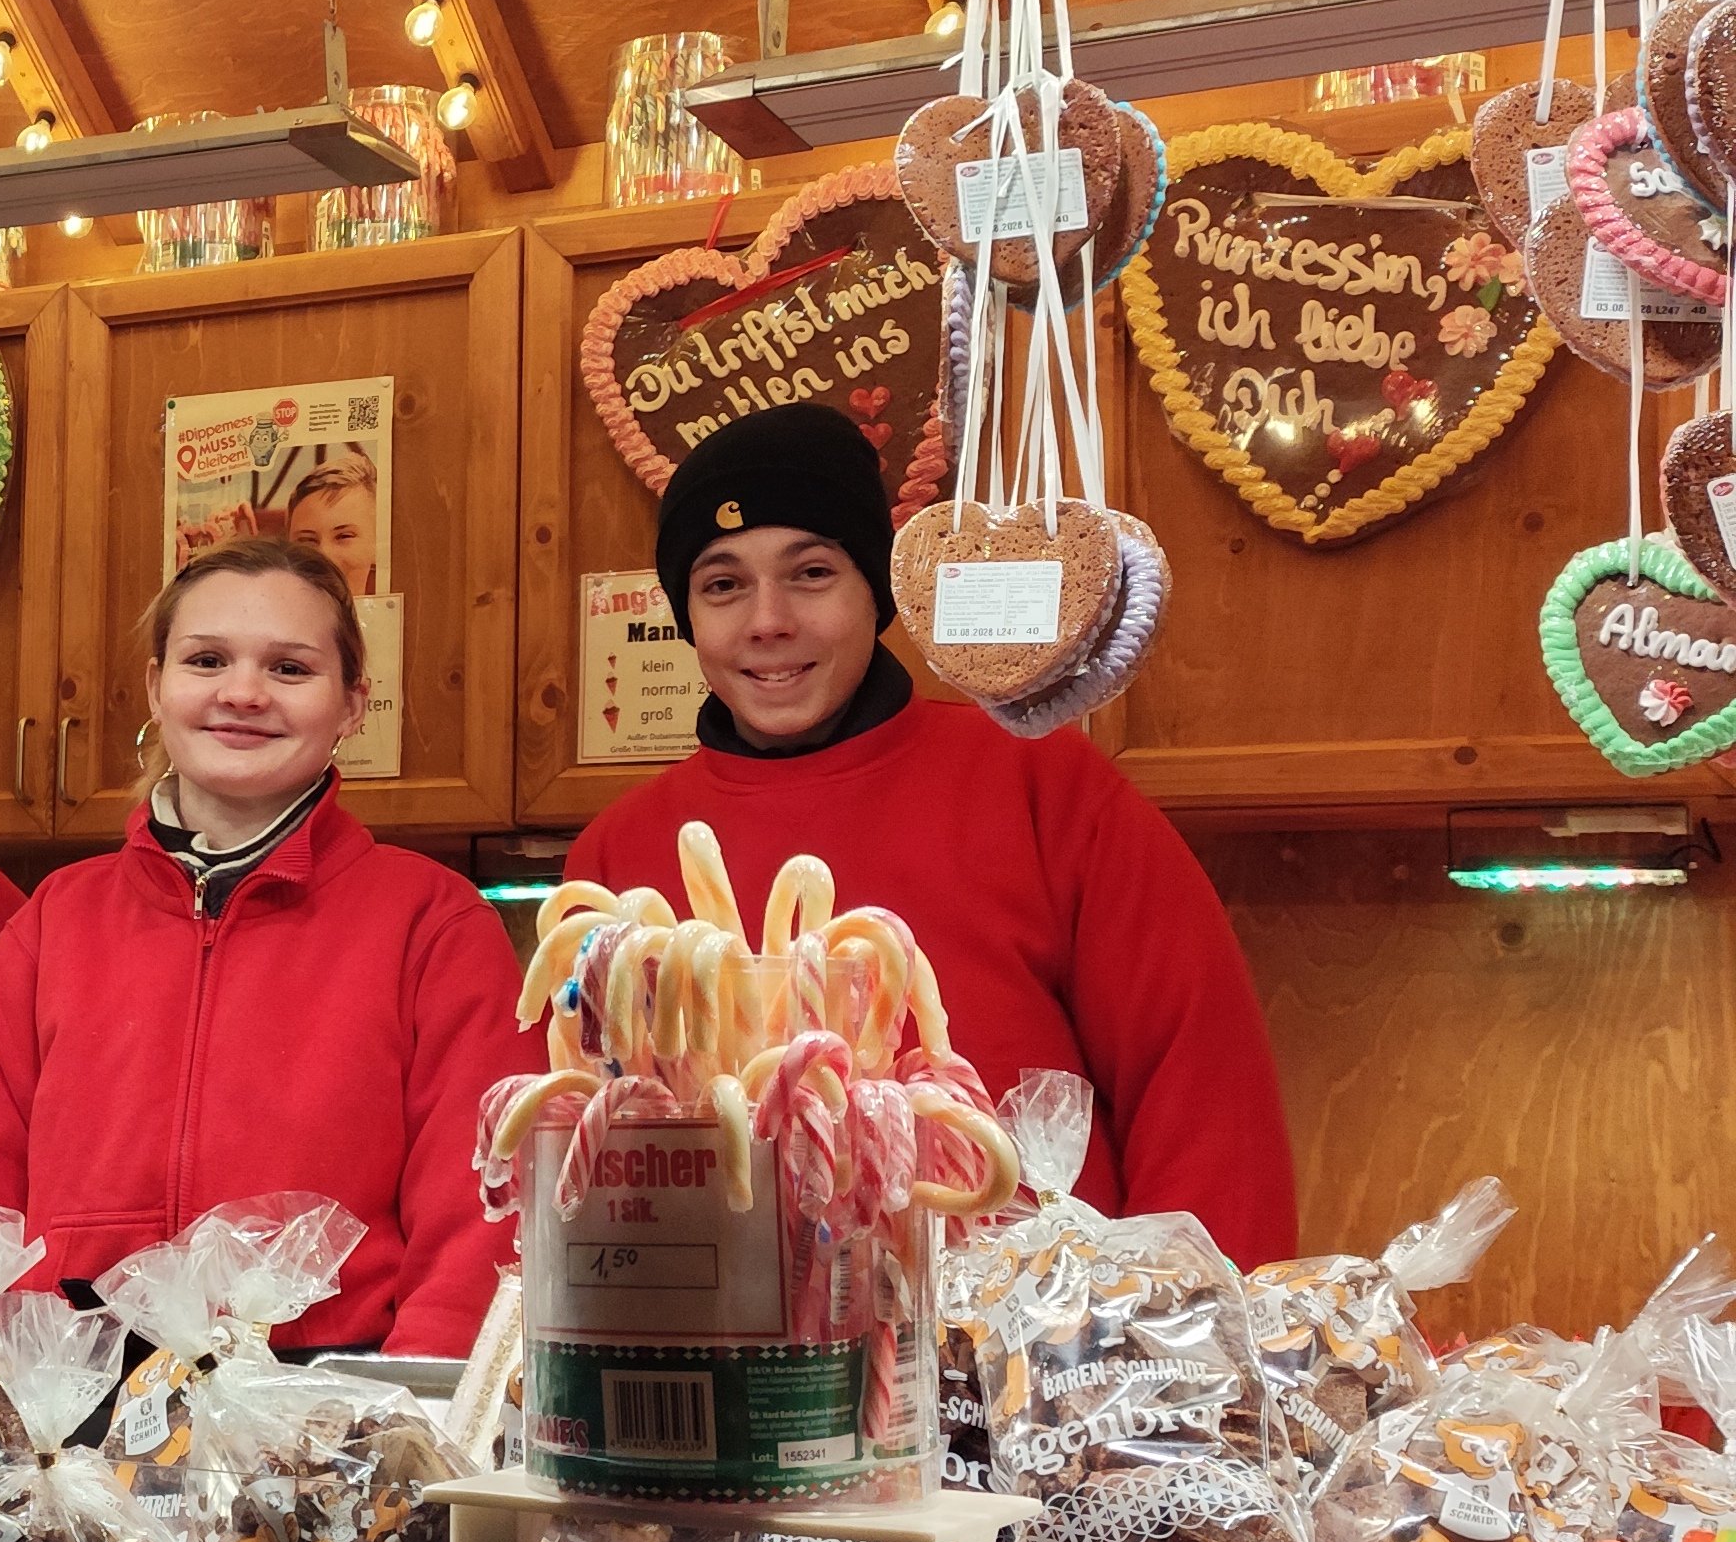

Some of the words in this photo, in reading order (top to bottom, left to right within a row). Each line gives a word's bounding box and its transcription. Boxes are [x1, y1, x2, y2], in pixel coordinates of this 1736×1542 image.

[1167, 197, 1448, 311] Prinzessin,
[625, 359, 703, 413] Du
[692, 286, 833, 379] triffst
[829, 250, 942, 321] mich
[1196, 279, 1275, 352] ich
[1295, 298, 1416, 371] liebe
[833, 318, 911, 379] ins
[1217, 366, 1339, 435] Dich
[275, 405, 296, 419] STOP
[178, 415, 254, 444] #Dippemess
[199, 435, 237, 457] MUSS
[197, 448, 249, 471] bleiben!
[1026, 627, 1039, 635] 40
[642, 660, 674, 672] klein
[641, 682, 691, 696] normal
[641, 707, 674, 724] groß
[589, 1143, 717, 1189] tscher
[591, 1248, 638, 1280] 1,50
[130, 1424, 161, 1445] SCHMIDT
[784, 1448, 826, 1462] 1552341
[1449, 1509, 1499, 1526] SCHMIDT
